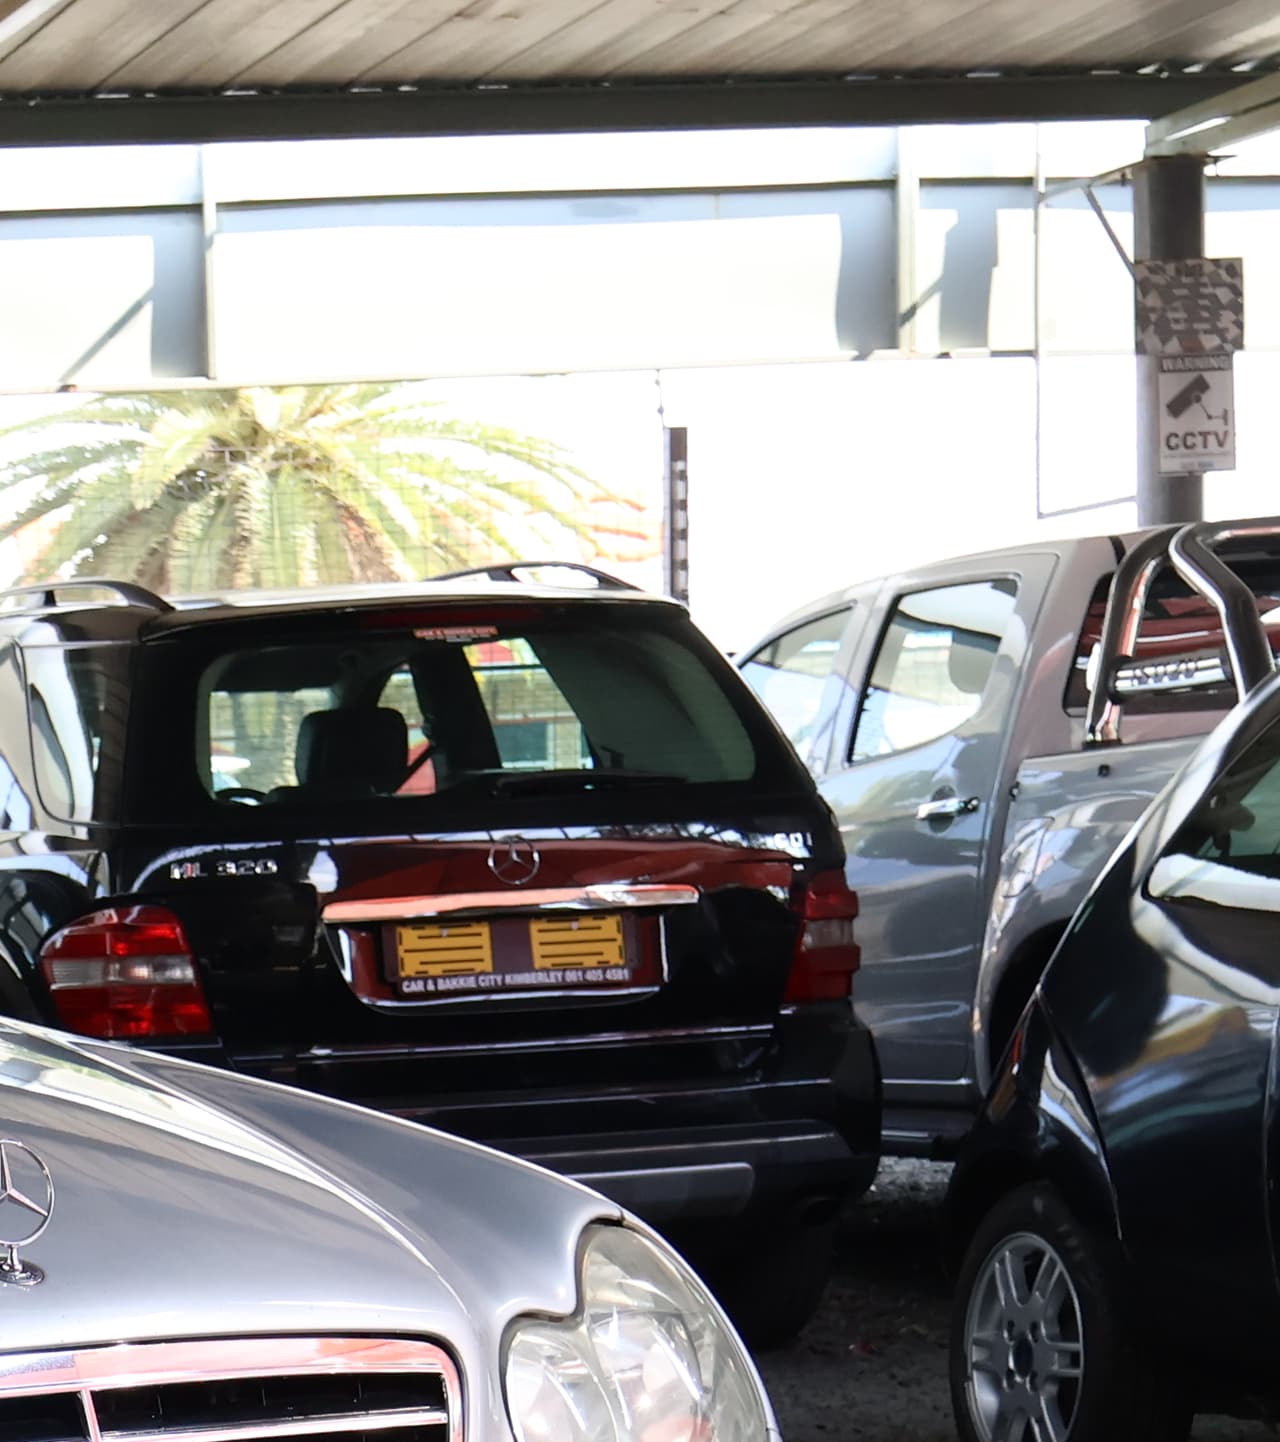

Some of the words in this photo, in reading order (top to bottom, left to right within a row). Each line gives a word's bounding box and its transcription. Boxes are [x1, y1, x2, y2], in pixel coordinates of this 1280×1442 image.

[1162, 356, 1231, 370] WARNING
[1166, 430, 1229, 450] CCTV
[170, 862, 208, 879] ML
[216, 860, 278, 877] 320
[402, 980, 425, 993] CAR
[477, 973, 503, 988] CITY
